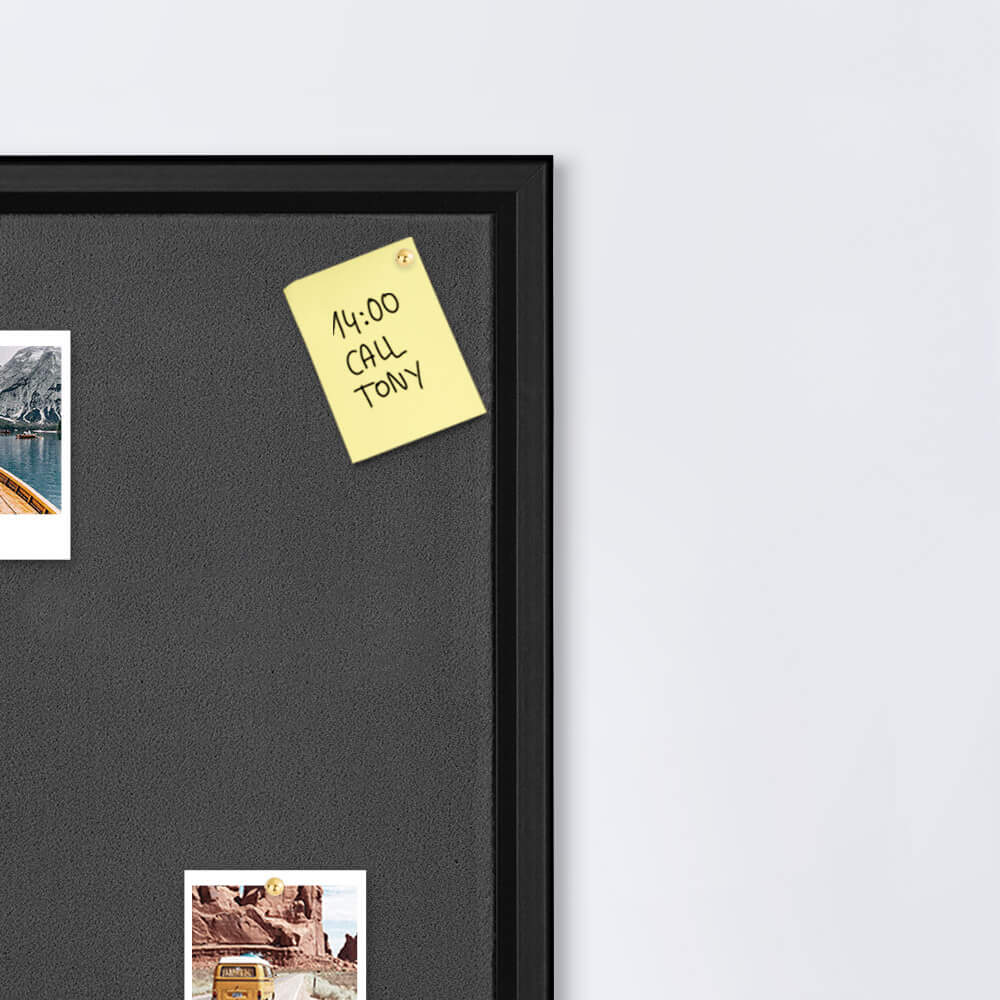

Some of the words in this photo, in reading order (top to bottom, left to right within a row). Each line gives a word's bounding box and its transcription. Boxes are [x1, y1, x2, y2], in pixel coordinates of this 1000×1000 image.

[332, 292, 400, 339] 14:00
[345, 335, 408, 376] CALL
[353, 360, 424, 409] TONY
